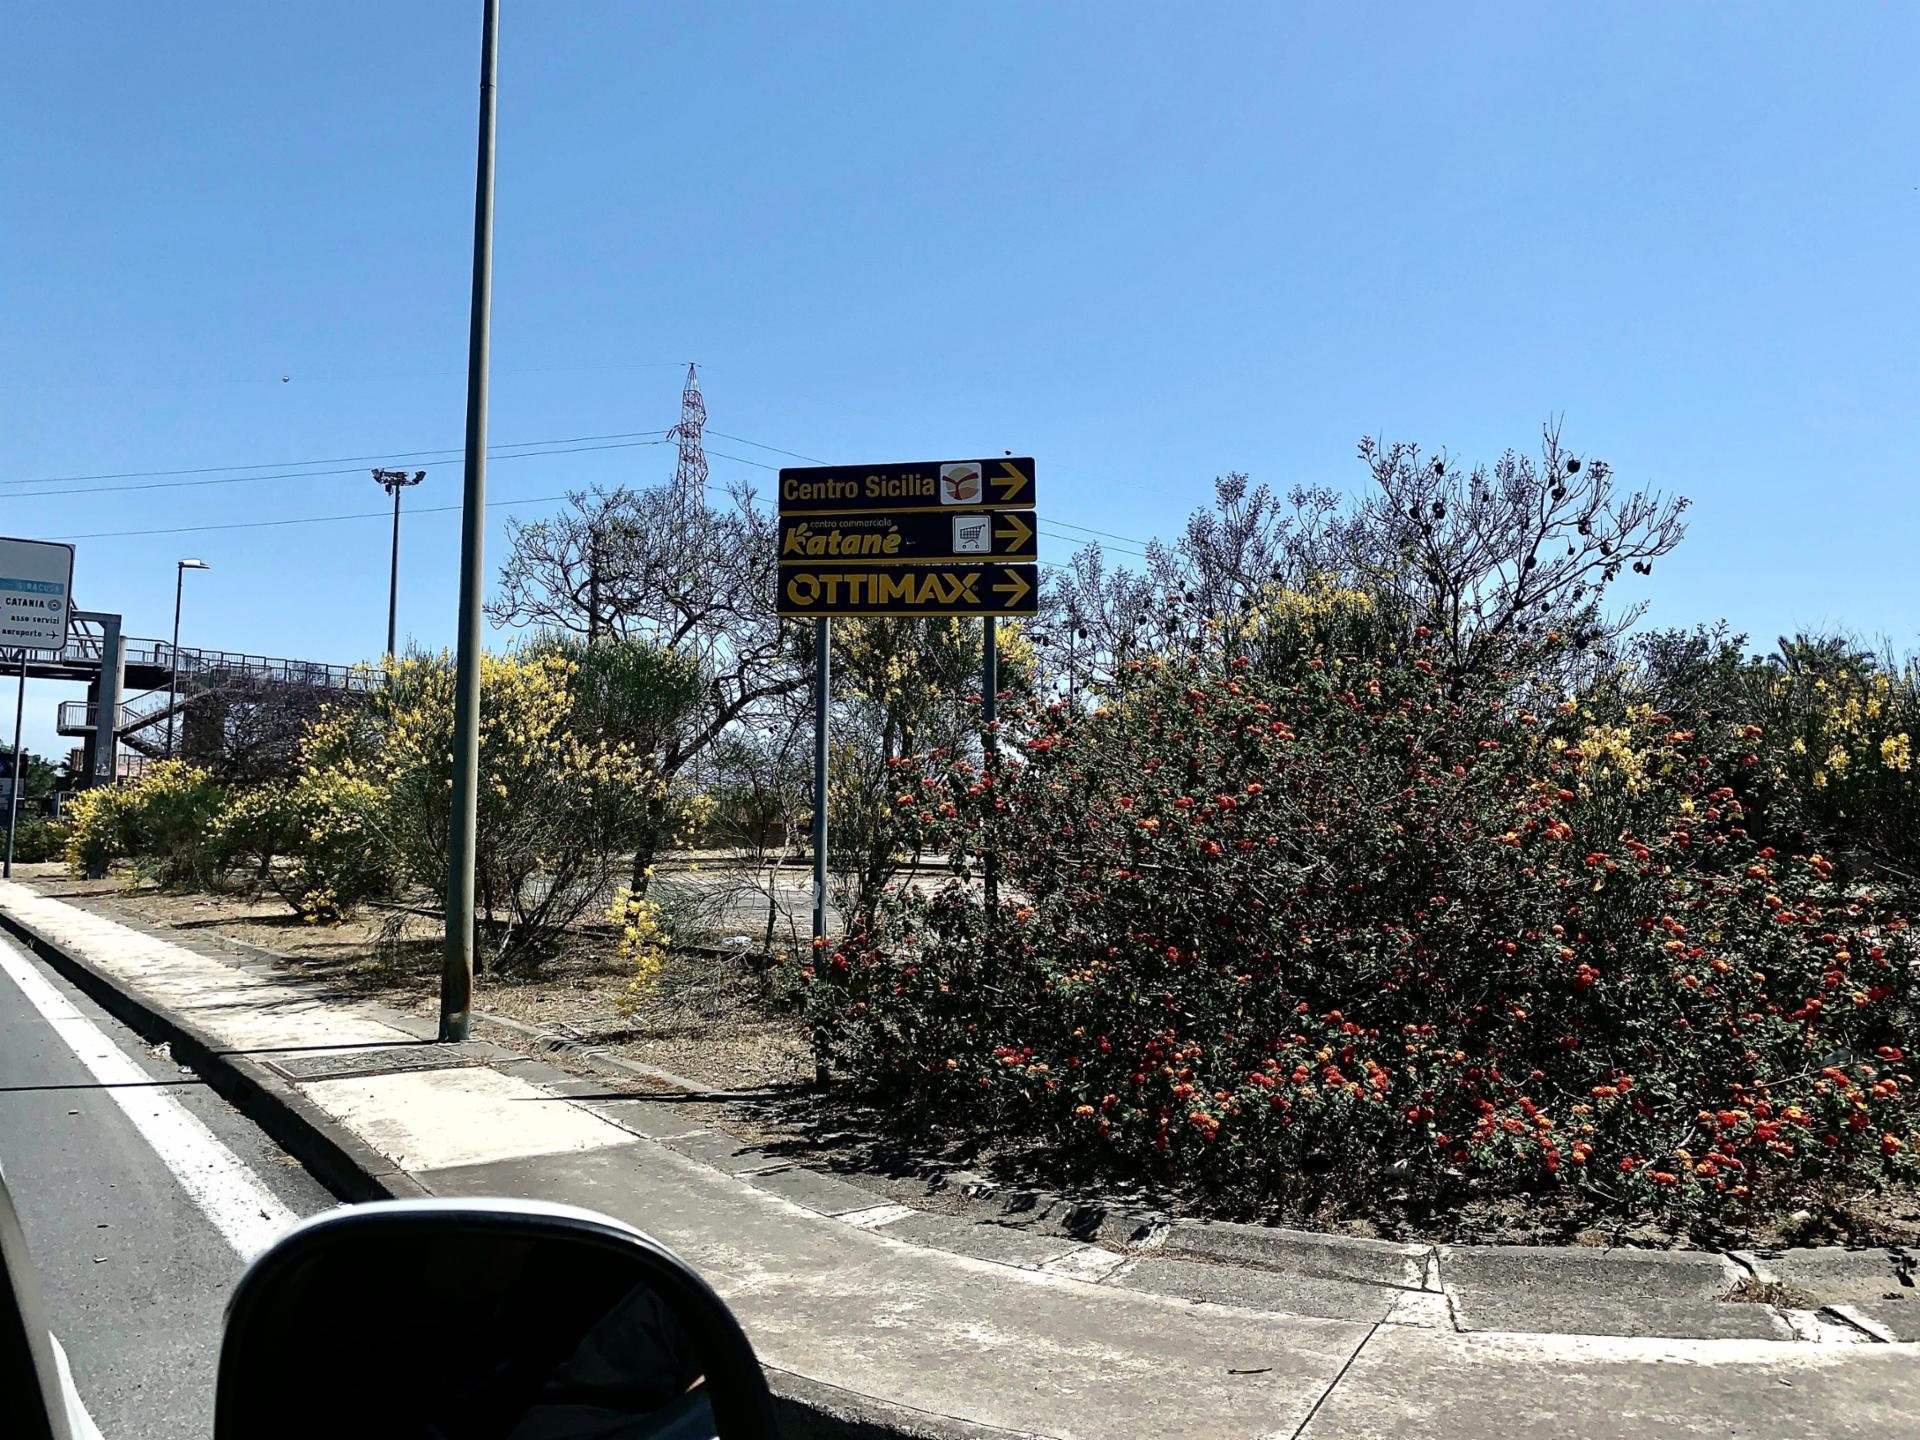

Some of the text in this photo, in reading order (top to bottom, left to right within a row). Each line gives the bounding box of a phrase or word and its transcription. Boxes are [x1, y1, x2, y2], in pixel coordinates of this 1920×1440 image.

[783, 474, 935, 500] Centro Sicilia
[810, 518, 892, 528] centro commerciale
[783, 522, 901, 555] Katané
[787, 573, 981, 605] OTTIMAX
[6, 597, 44, 608] CATANIA
[33, 616, 60, 624] servizi
[2, 628, 42, 638] aeroporto
